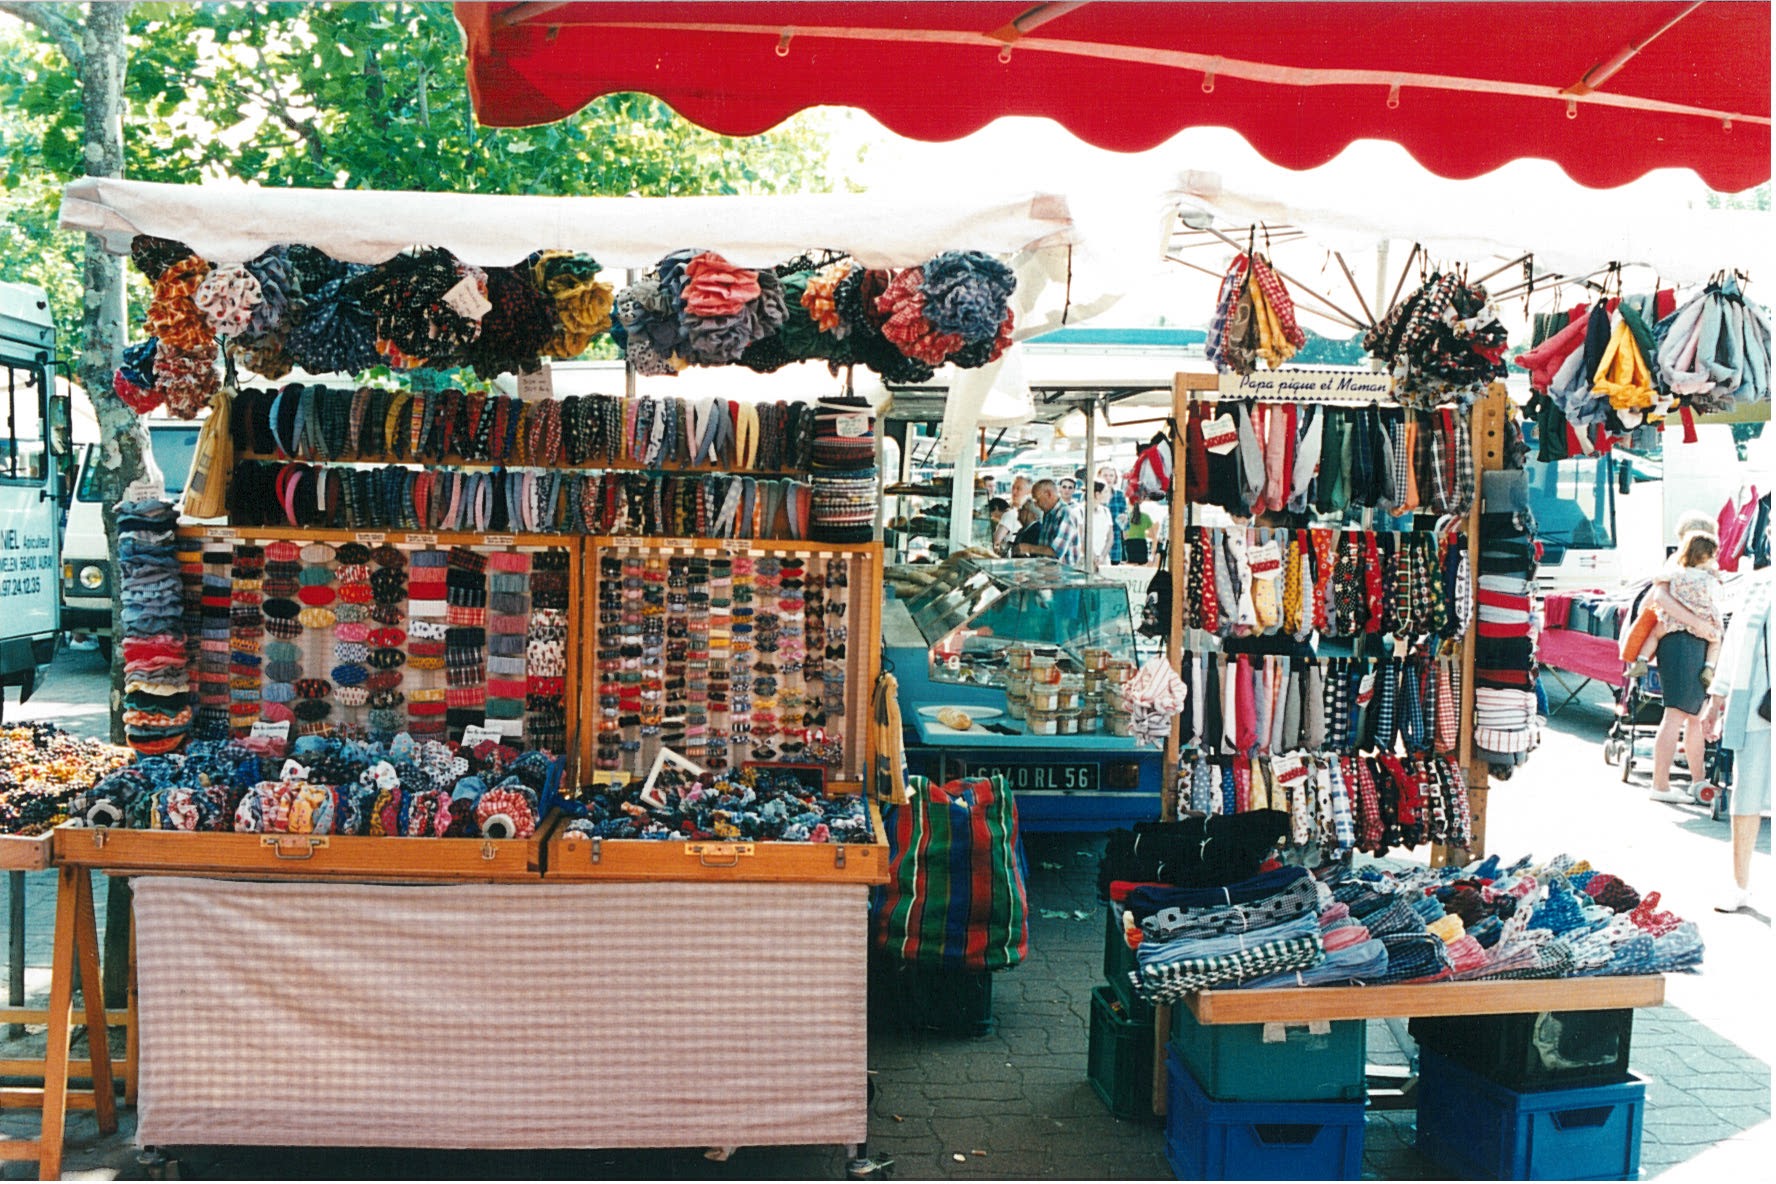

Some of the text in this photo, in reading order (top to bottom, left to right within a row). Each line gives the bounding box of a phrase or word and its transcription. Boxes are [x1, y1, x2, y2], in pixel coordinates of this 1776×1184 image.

[1240, 373, 1386, 394] Papa pique et Maman
[1035, 767, 1058, 788] RL
[1065, 767, 1088, 788] 56
